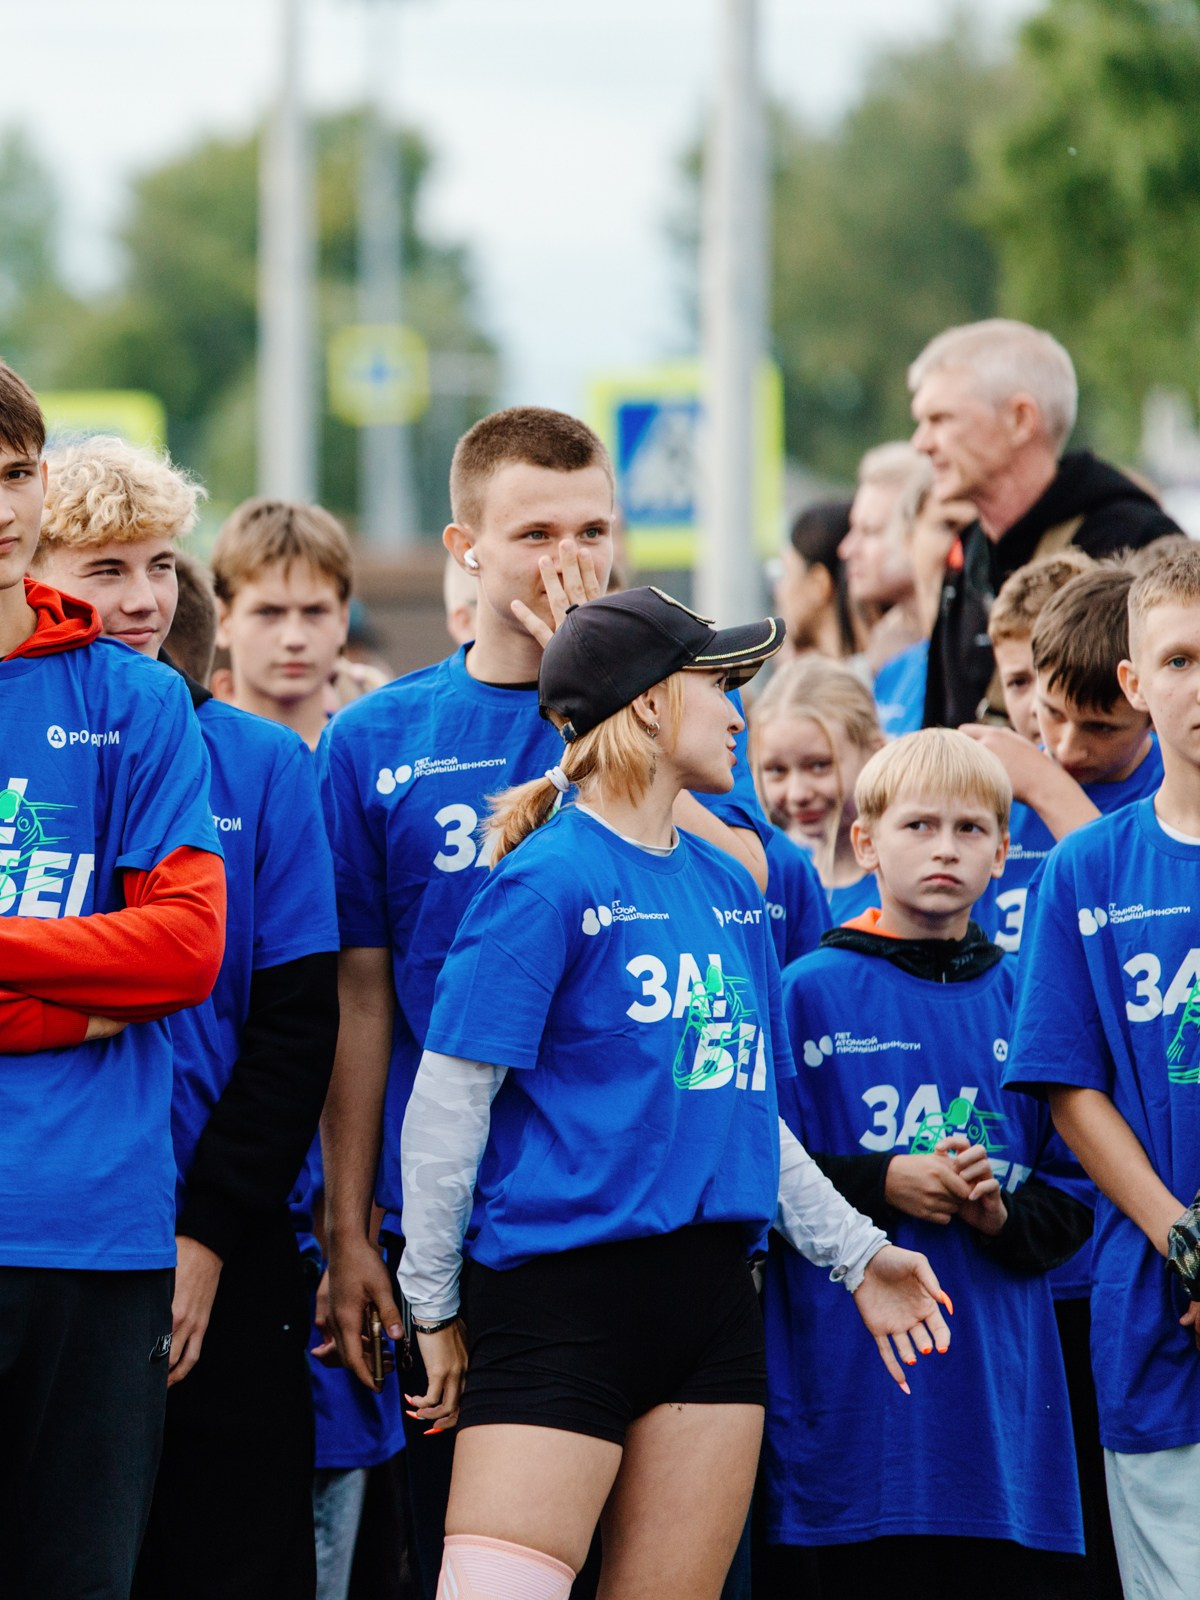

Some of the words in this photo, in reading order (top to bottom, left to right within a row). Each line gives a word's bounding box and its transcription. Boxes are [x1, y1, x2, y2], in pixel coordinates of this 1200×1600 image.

[414, 756, 430, 768] ЛЕТ
[414, 756, 459, 774] АТОМНОЙ
[625, 953, 728, 1024] ЗА!
[834, 1032, 852, 1041] ЛЕТ
